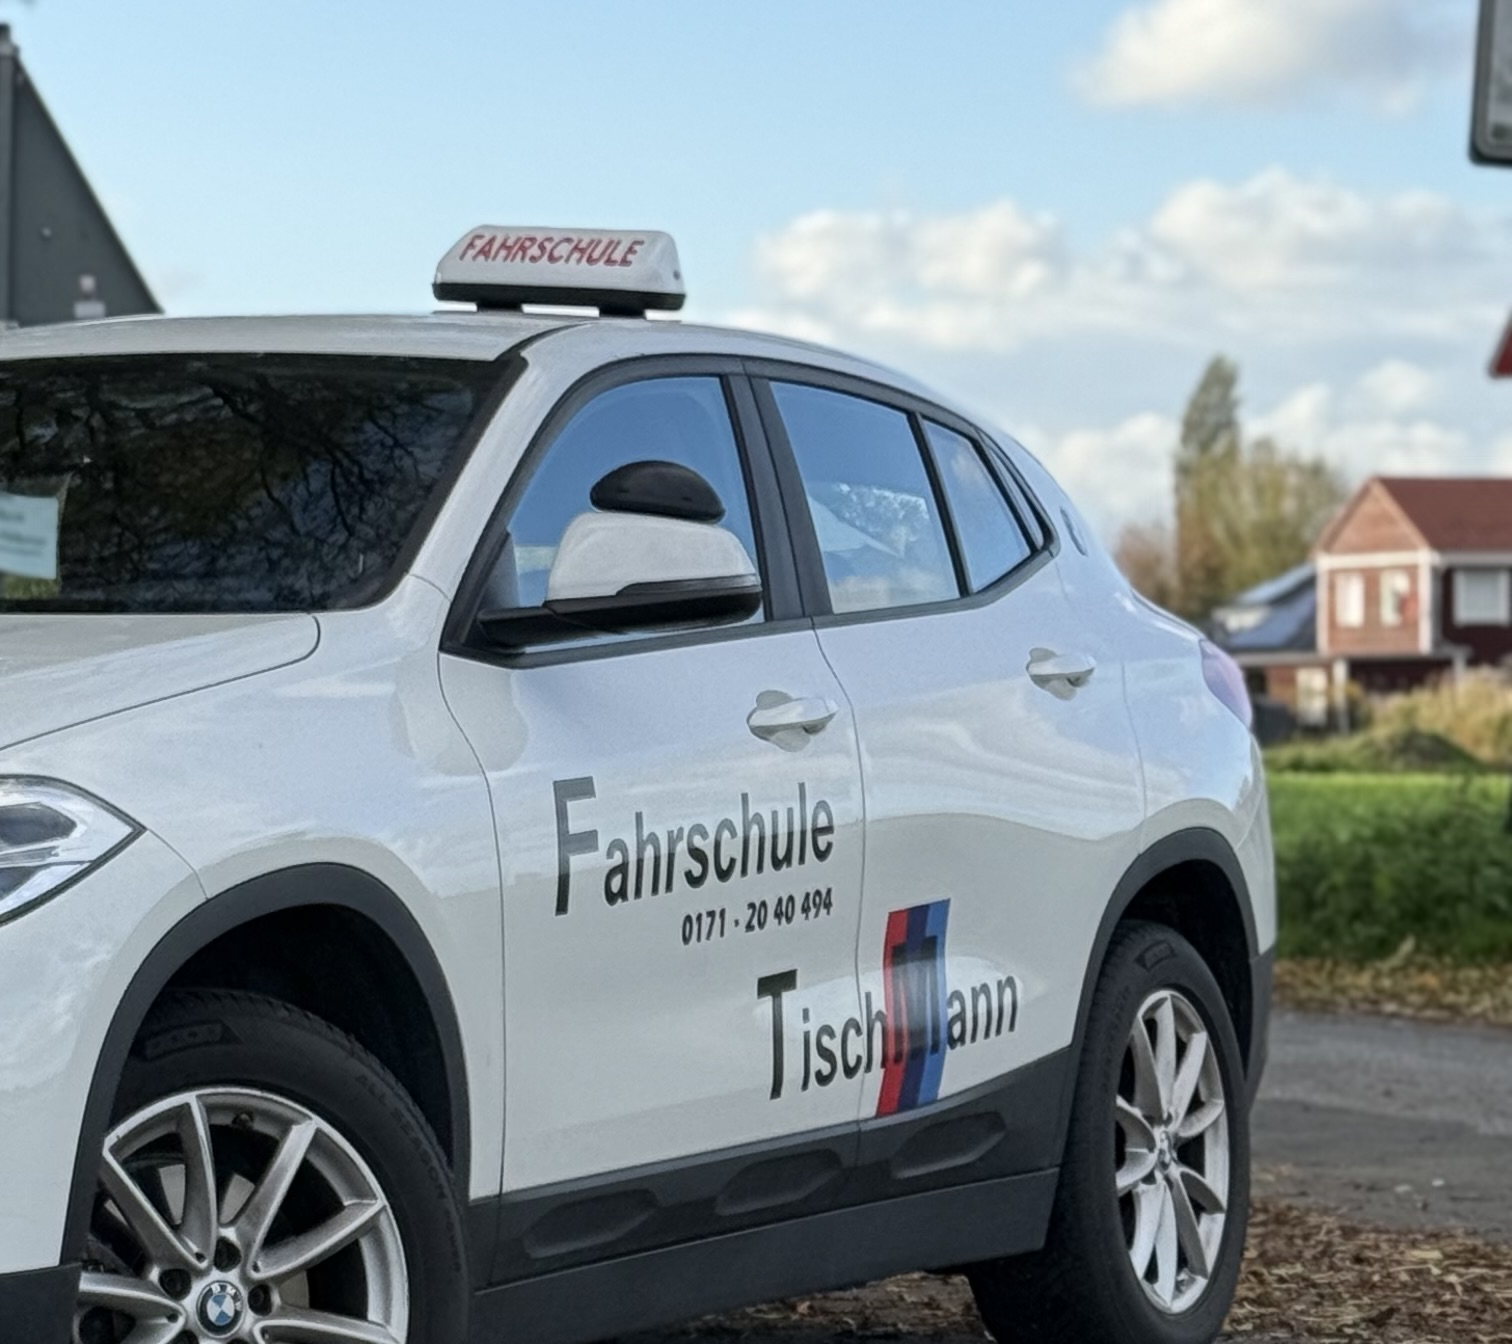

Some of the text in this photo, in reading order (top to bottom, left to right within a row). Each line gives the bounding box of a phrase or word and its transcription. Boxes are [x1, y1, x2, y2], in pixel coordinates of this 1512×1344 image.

[459, 234, 645, 267] FAHRSCHULE
[553, 775, 836, 917] Fahrschule
[681, 907, 726, 946] 0171
[744, 899, 768, 933] 20
[773, 894, 795, 926] 40
[801, 887, 833, 921] 494
